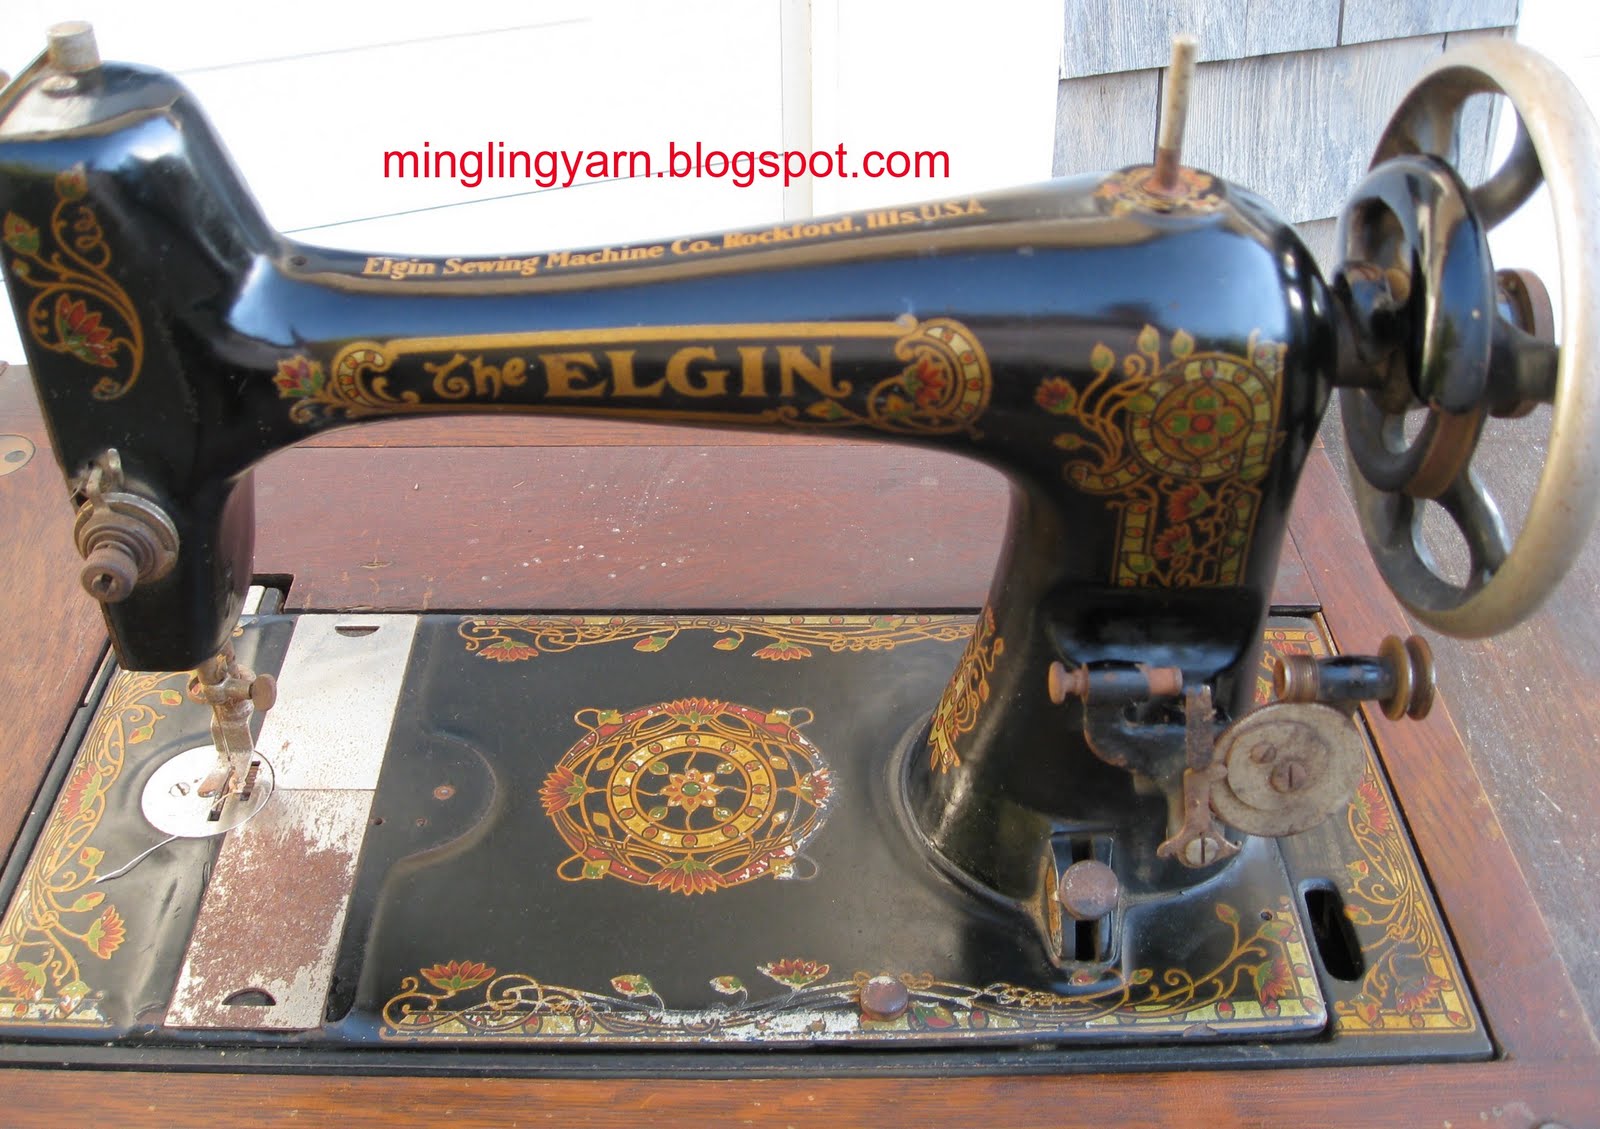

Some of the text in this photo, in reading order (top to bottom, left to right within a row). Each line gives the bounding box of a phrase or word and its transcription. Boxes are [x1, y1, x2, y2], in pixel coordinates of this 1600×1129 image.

[362, 256, 435, 280] Elgin
[443, 256, 540, 276] Sewing
[545, 247, 664, 269] Machine
[671, 239, 720, 256] Co.
[424, 345, 853, 398] The ELGIN
